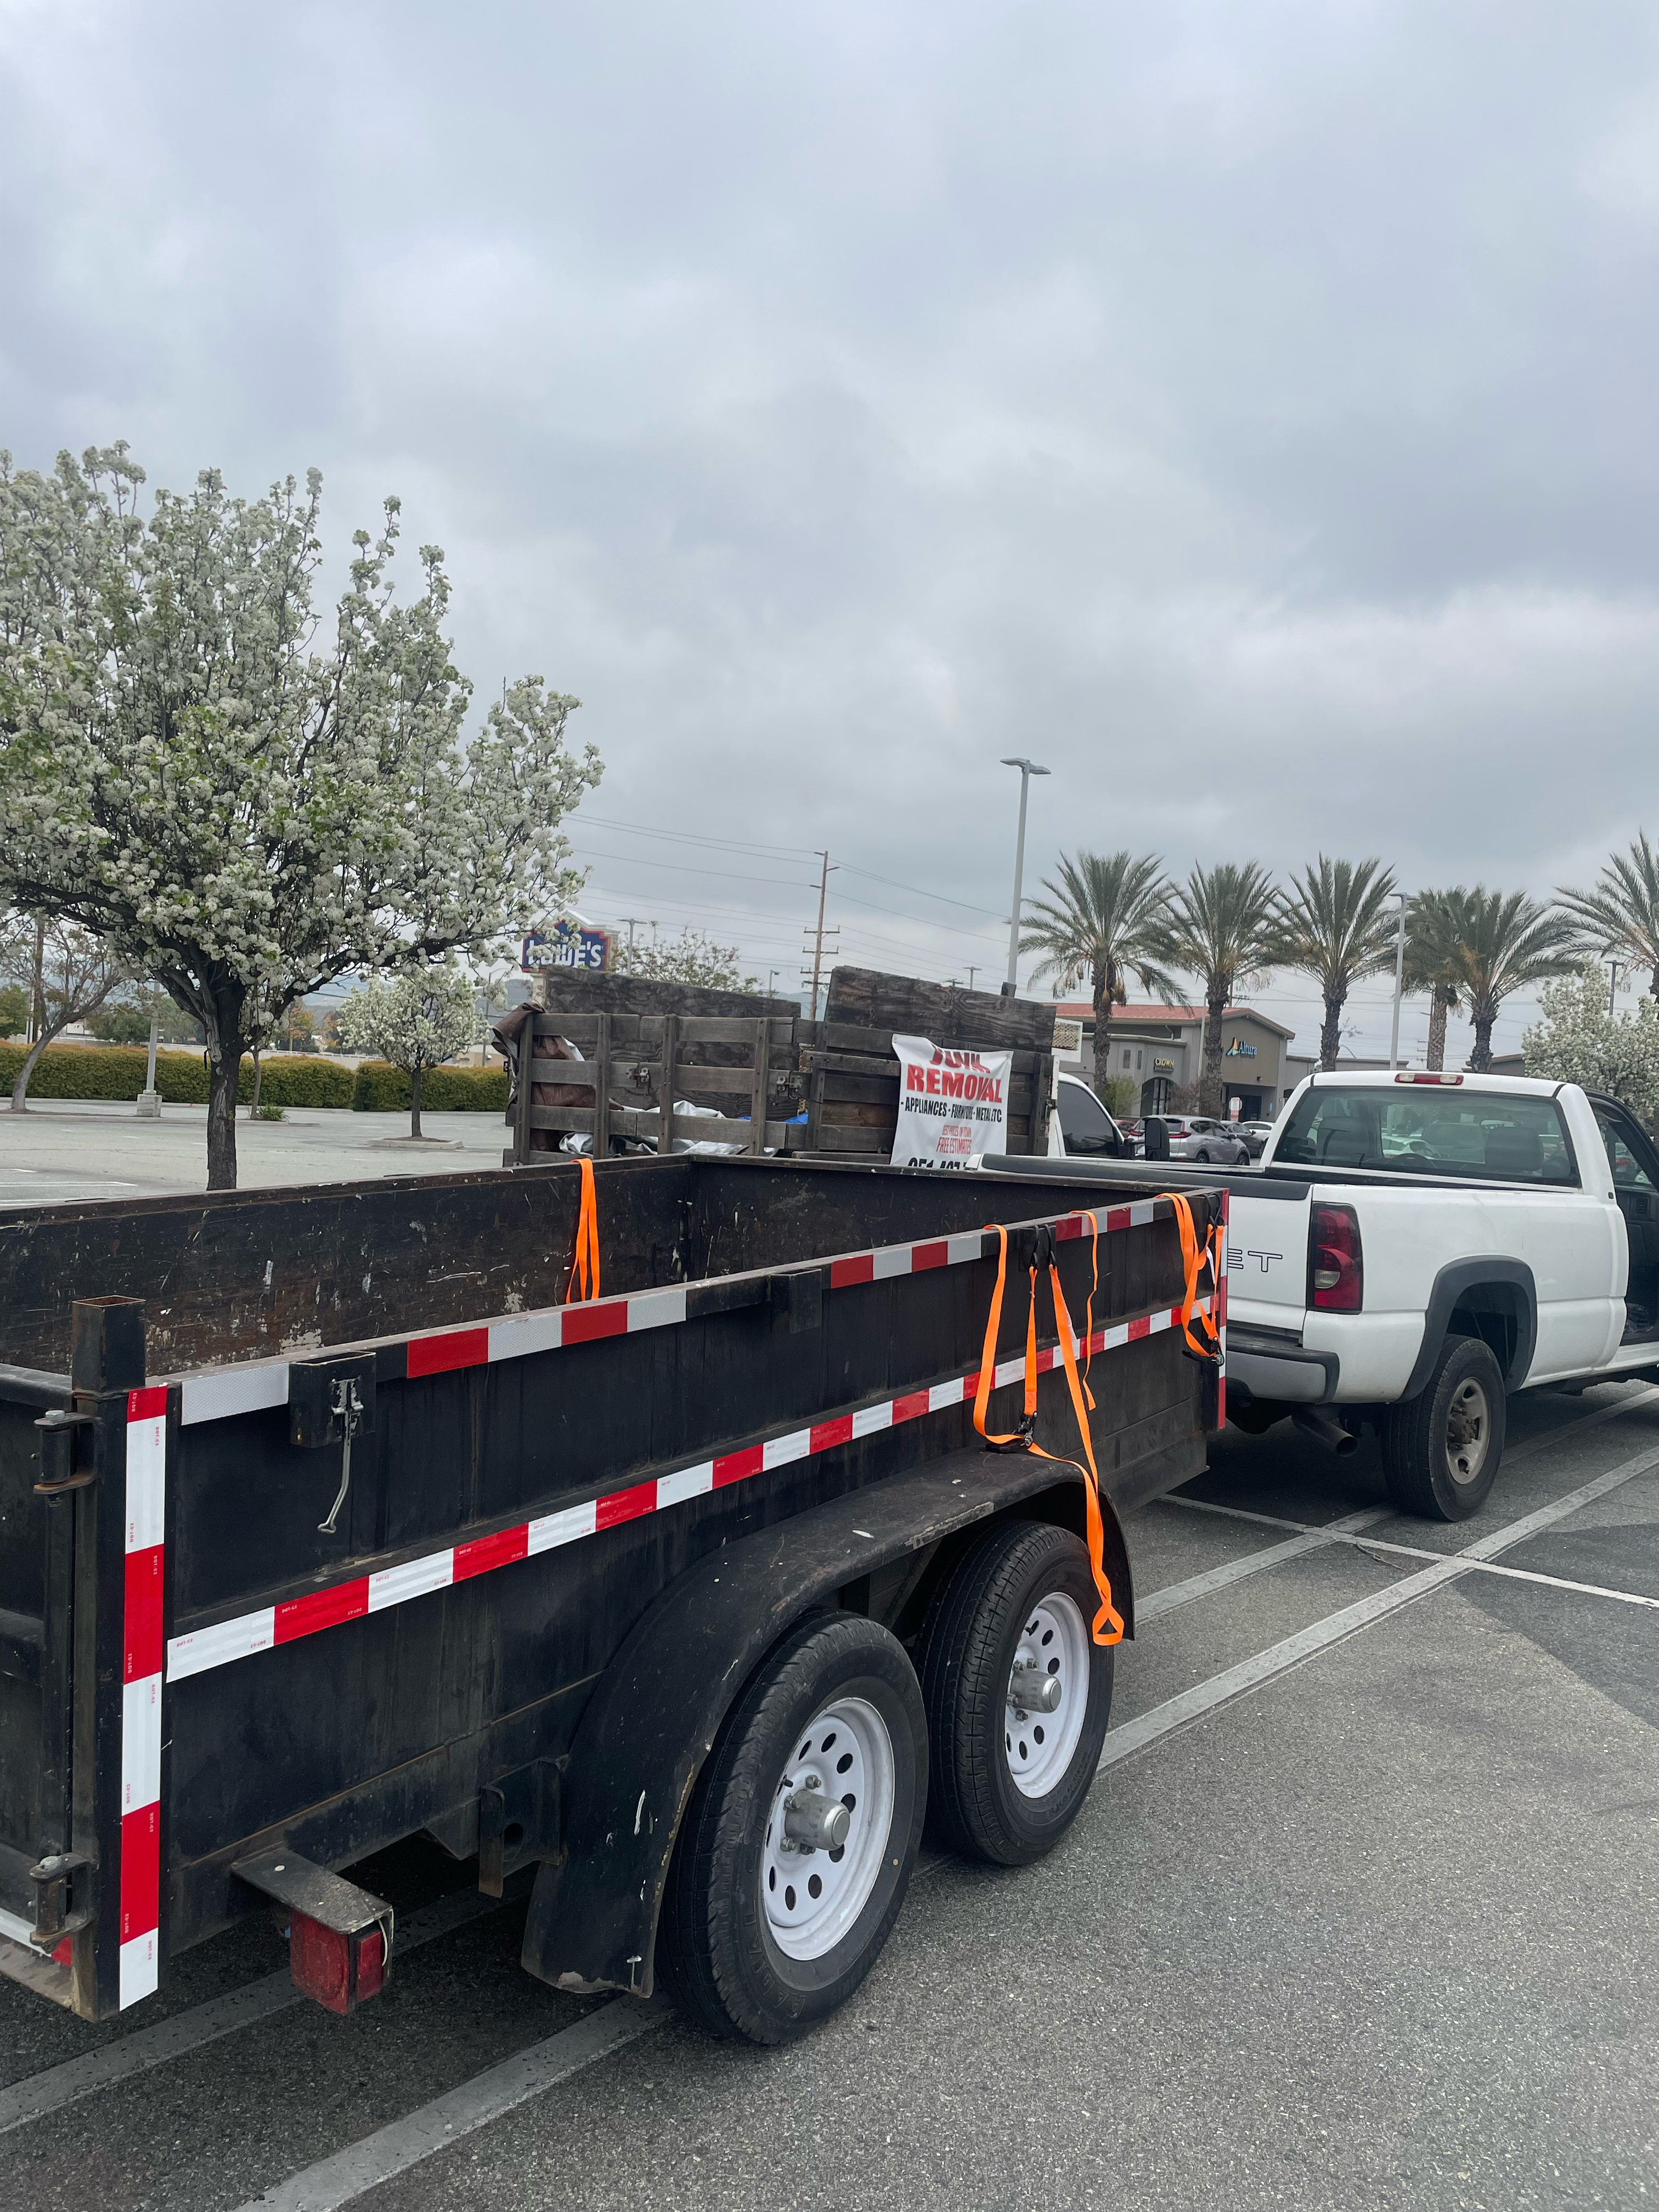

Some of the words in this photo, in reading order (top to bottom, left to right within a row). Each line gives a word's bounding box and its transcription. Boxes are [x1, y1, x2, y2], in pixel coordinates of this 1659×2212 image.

[1239, 1041, 1257, 1055] Altura
[1155, 1058, 1174, 1067] CROWN
[907, 1064, 1002, 1103] REMOVAL
[905, 1097, 947, 1118] APPLIANCES
[936, 1137, 950, 1153] FREE
[950, 1138, 972, 1155] ESTIMATES
